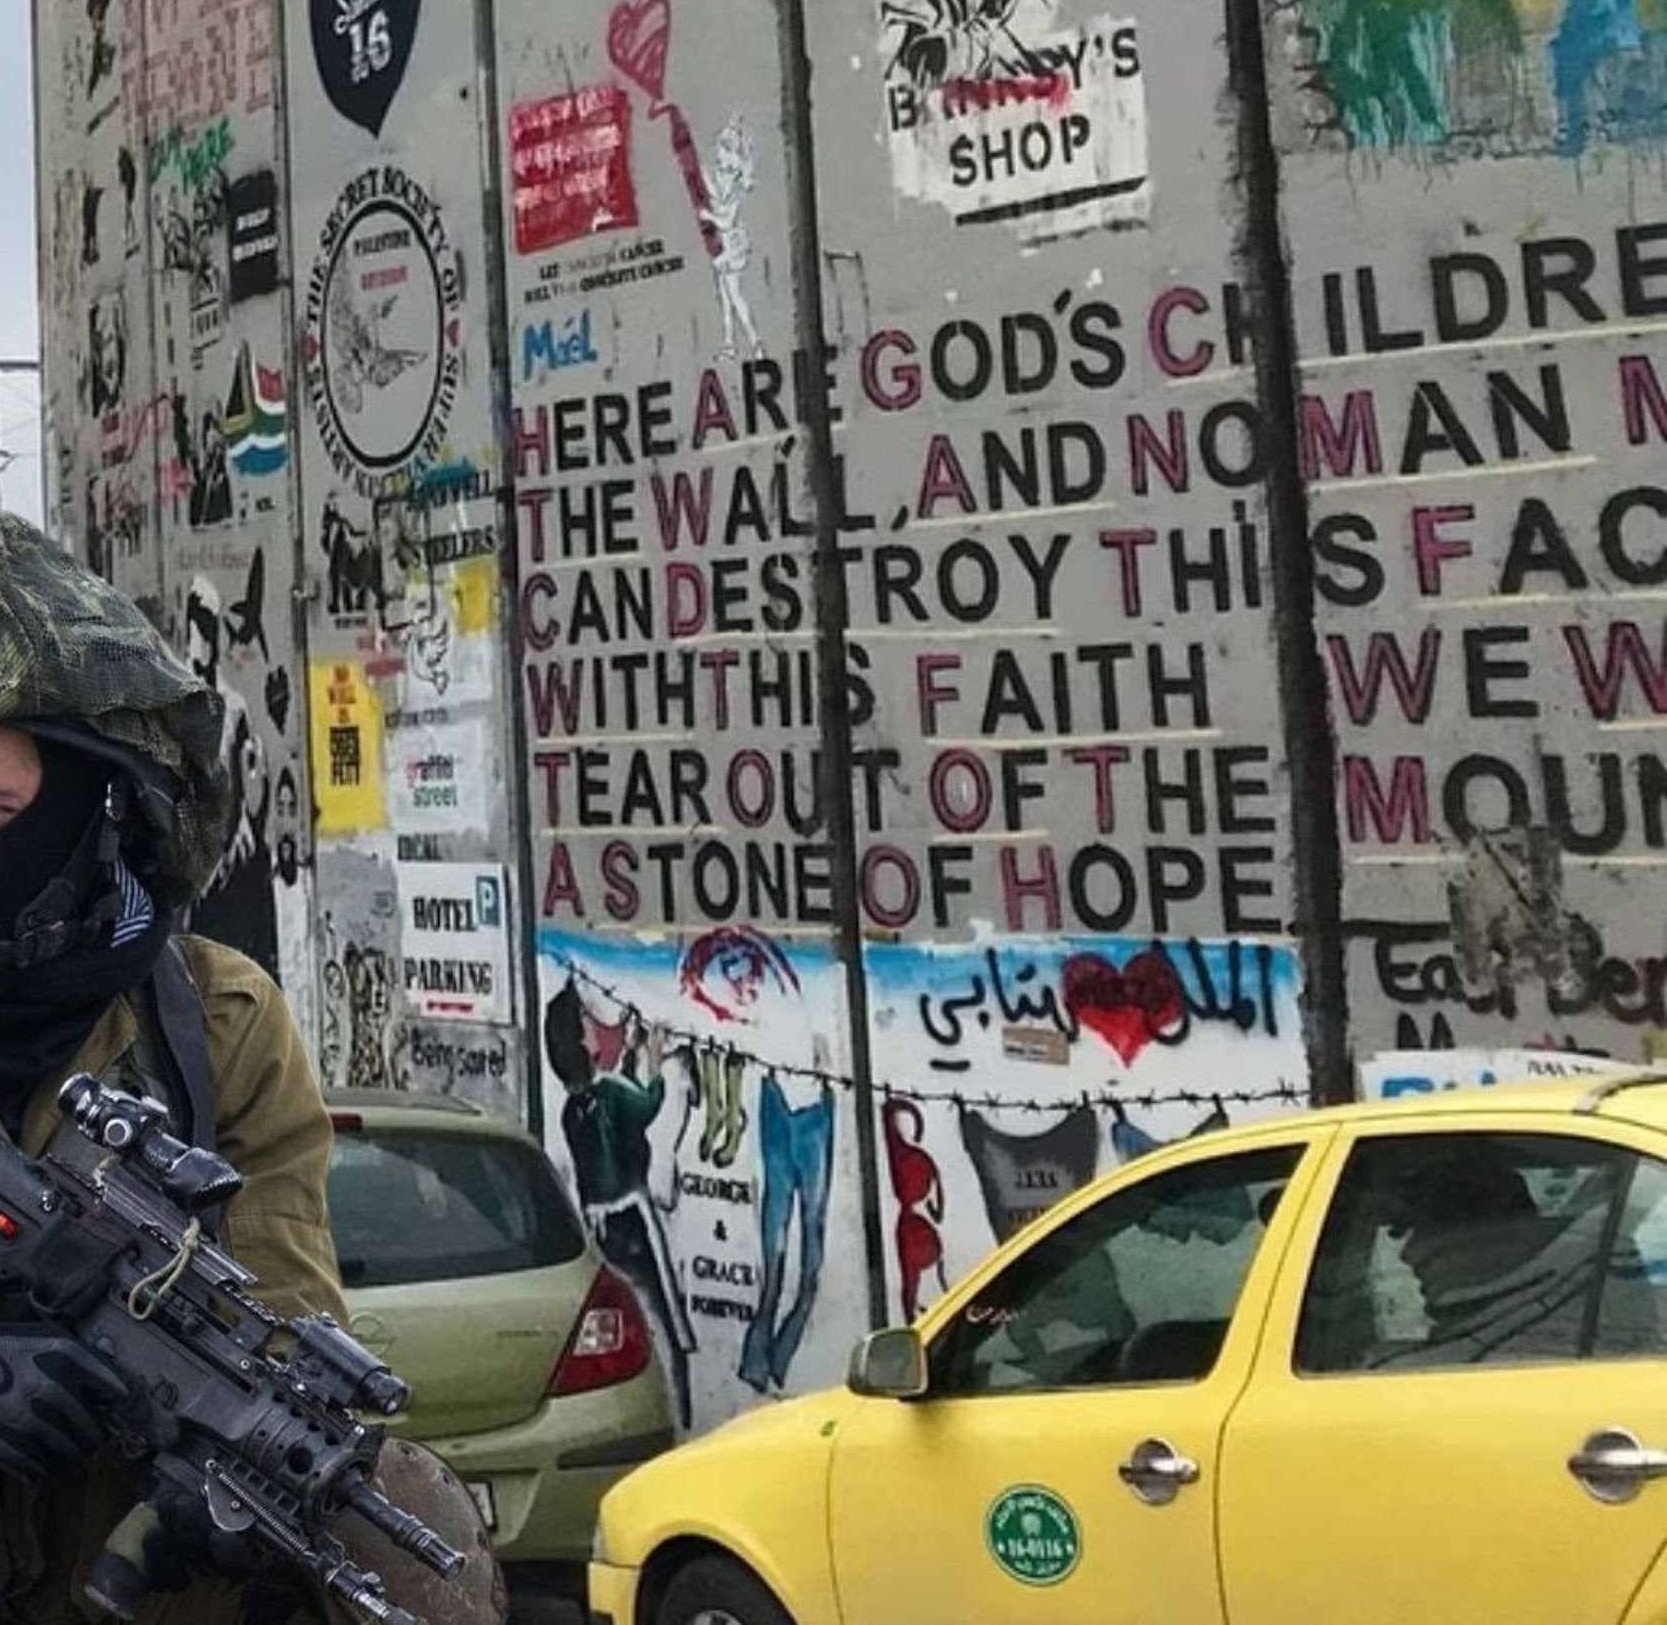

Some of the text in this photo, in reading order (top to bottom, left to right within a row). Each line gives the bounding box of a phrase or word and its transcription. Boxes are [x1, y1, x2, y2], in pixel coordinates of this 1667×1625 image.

[349, 11, 392, 71] 16
[949, 114, 1090, 187] SHOP
[512, 379, 677, 477] HERE
[690, 343, 845, 452] ARE
[859, 290, 1127, 412] GOD'S
[518, 480, 639, 562] THE
[916, 421, 1107, 519] AND
[1126, 400, 1264, 497] NO
[1295, 364, 1571, 478] MAN
[522, 567, 653, 652] CAN
[666, 533, 1071, 640] DESTROY
[1098, 500, 1386, 618] THIS
[528, 649, 695, 738] WITH
[699, 641, 877, 731] THIS
[916, 641, 1213, 737] FAITH
[1326, 624, 1539, 727] WE
[534, 749, 712, 829] TEAR
[726, 749, 901, 838] OUT
[928, 747, 1050, 834] OF
[1063, 744, 1276, 836] THE
[413, 895, 478, 932] HOTEL
[542, 843, 585, 920] A
[599, 838, 834, 922] STONE
[858, 843, 974, 930] OF
[403, 956, 493, 995] PARKING
[681, 1172, 753, 1204] GEORGE
[714, 1220, 728, 1241] &
[693, 1255, 753, 1286] GRACE
